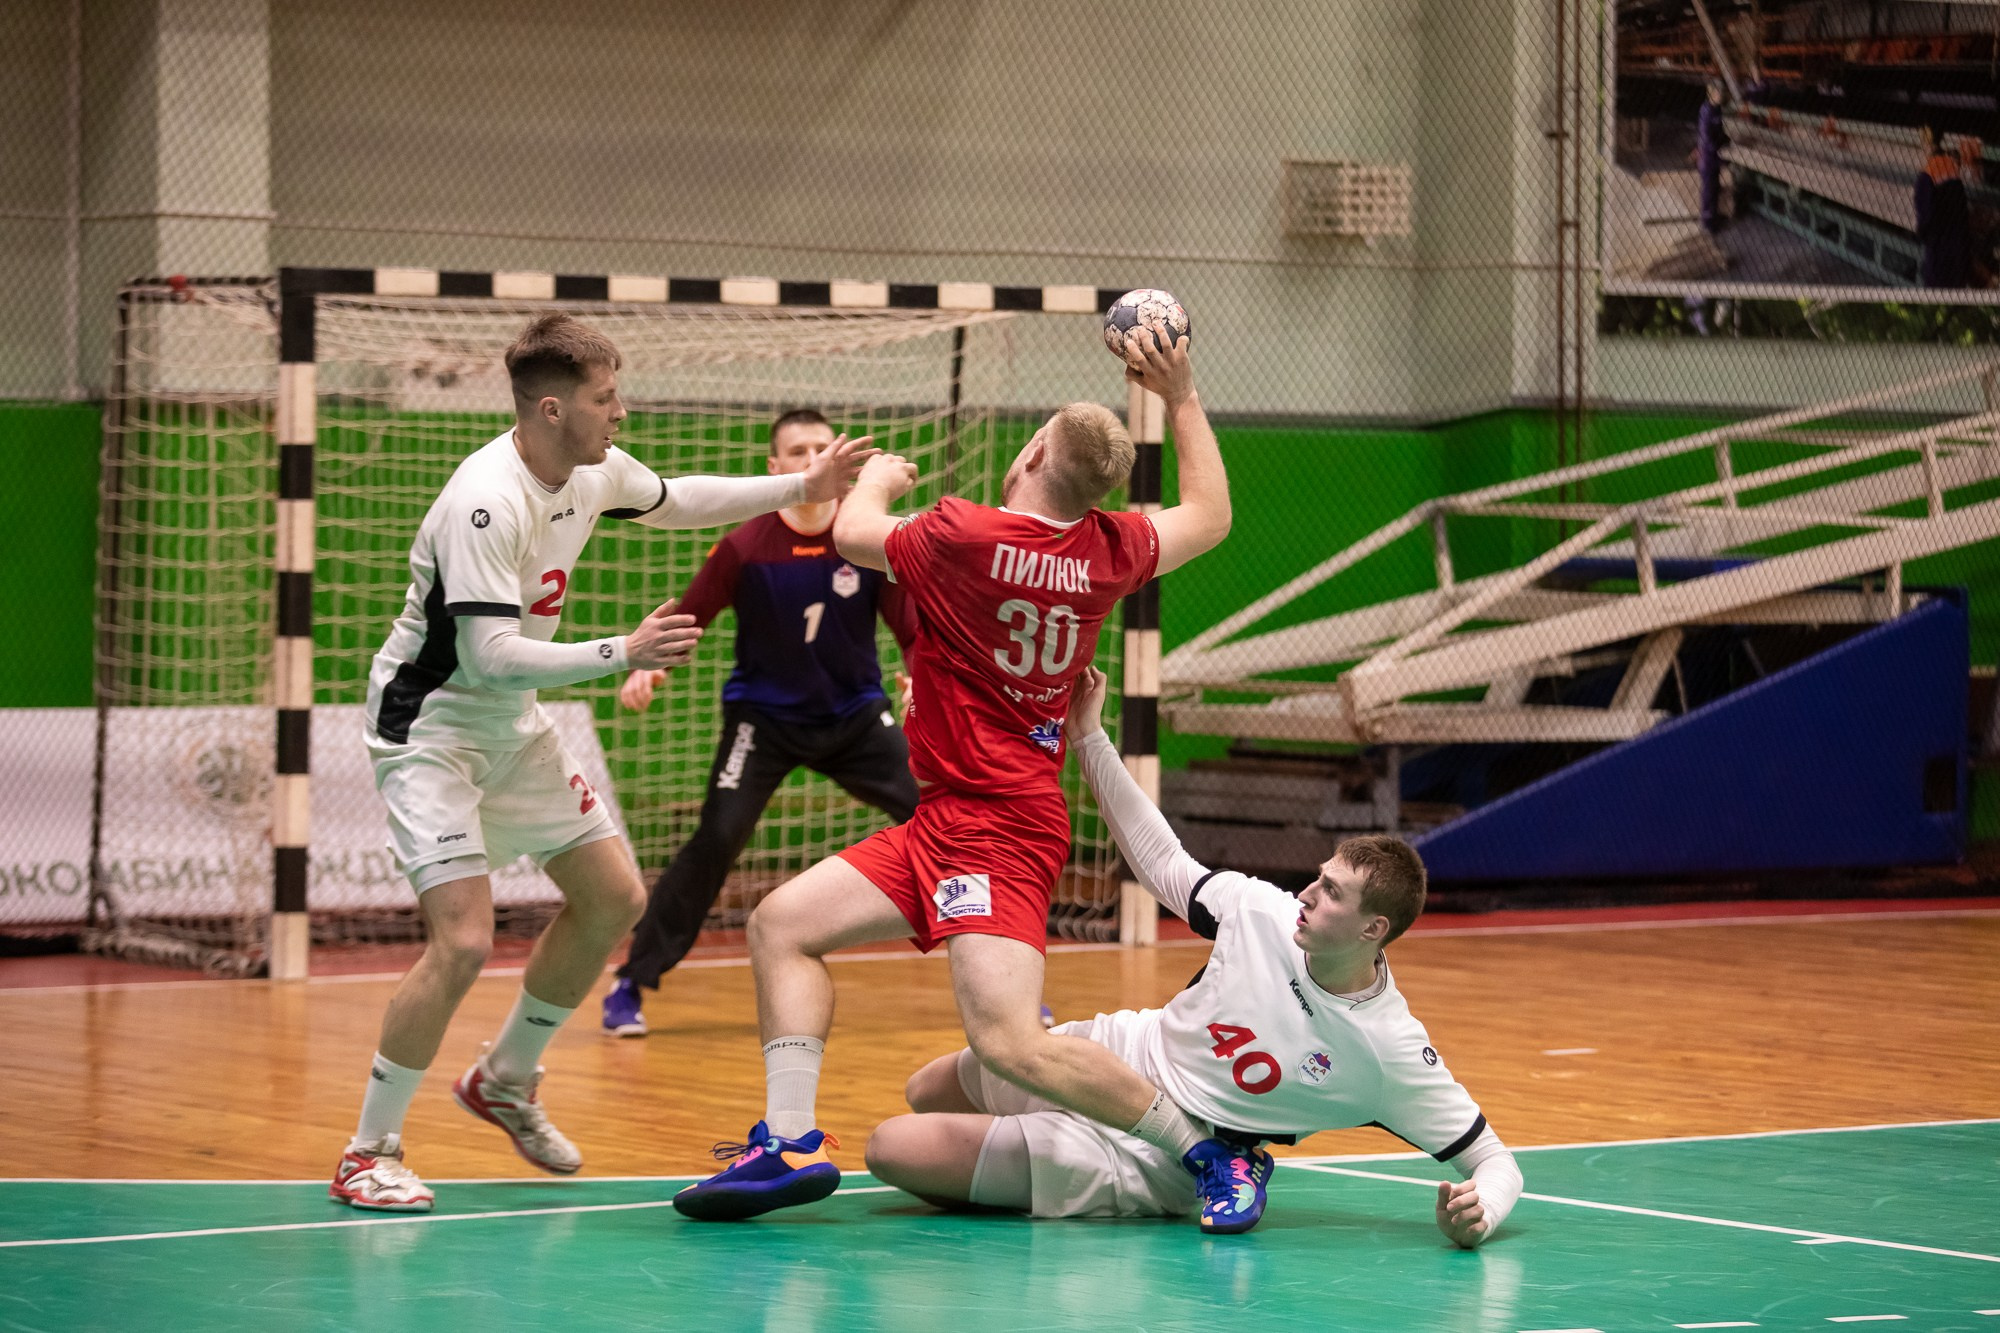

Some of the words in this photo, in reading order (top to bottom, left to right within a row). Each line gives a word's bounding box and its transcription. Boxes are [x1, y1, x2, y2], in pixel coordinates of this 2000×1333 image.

[990, 543, 1092, 594] ПИЛЮК
[803, 601, 826, 644] 1
[993, 598, 1081, 678] 30
[716, 721, 756, 790] Kempa
[1289, 978, 1314, 1018] Kempa
[762, 1041, 806, 1056] empa
[1206, 1022, 1282, 1095] 40
